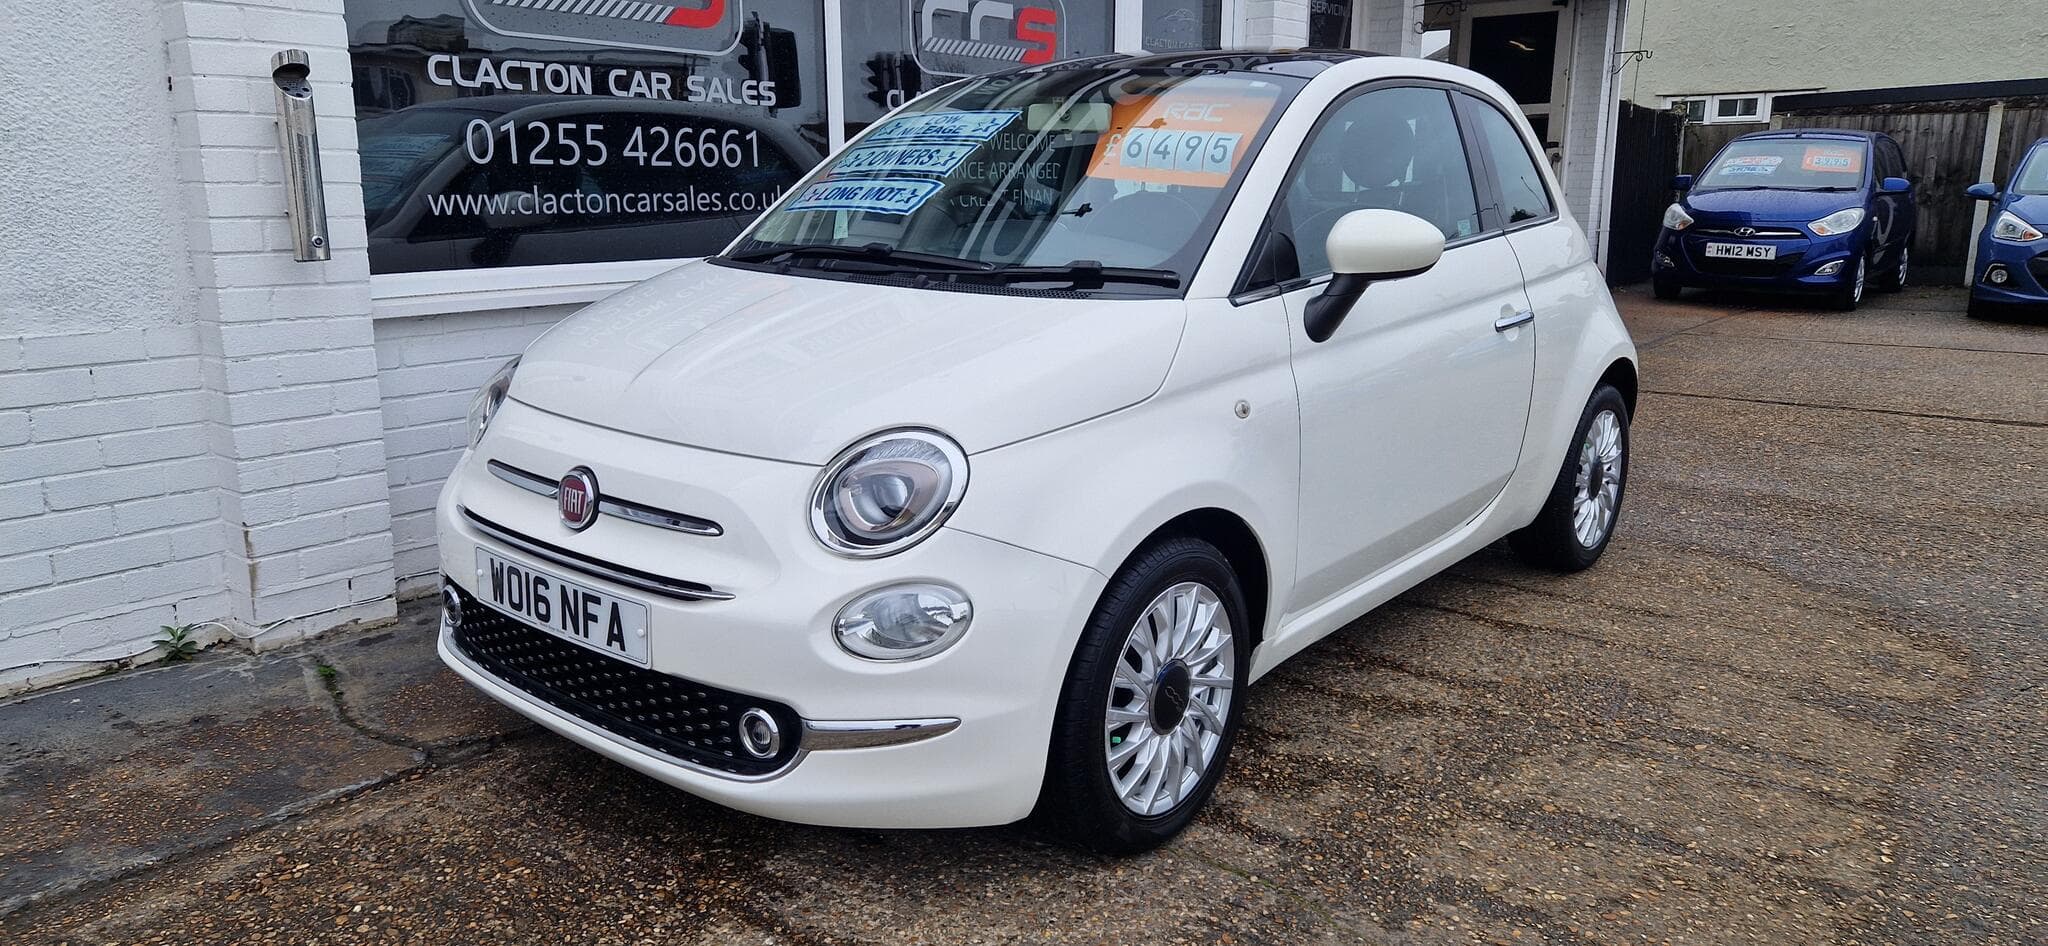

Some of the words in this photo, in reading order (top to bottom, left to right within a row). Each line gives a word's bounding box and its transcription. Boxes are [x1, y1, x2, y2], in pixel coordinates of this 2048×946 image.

[427, 54, 592, 95] CLACTON
[608, 69, 672, 100] CAR
[686, 75, 777, 106] SALES
[925, 115, 963, 125] LOW
[466, 118, 608, 166] 01255
[623, 126, 759, 168] 426661
[816, 186, 863, 201] LONG
[861, 187, 907, 201] MOT
[1716, 245, 1743, 256] HW12
[1746, 246, 1771, 258] MSY
[563, 487, 585, 514] FIAT
[489, 557, 551, 624] WO16
[560, 584, 626, 652] NFA
